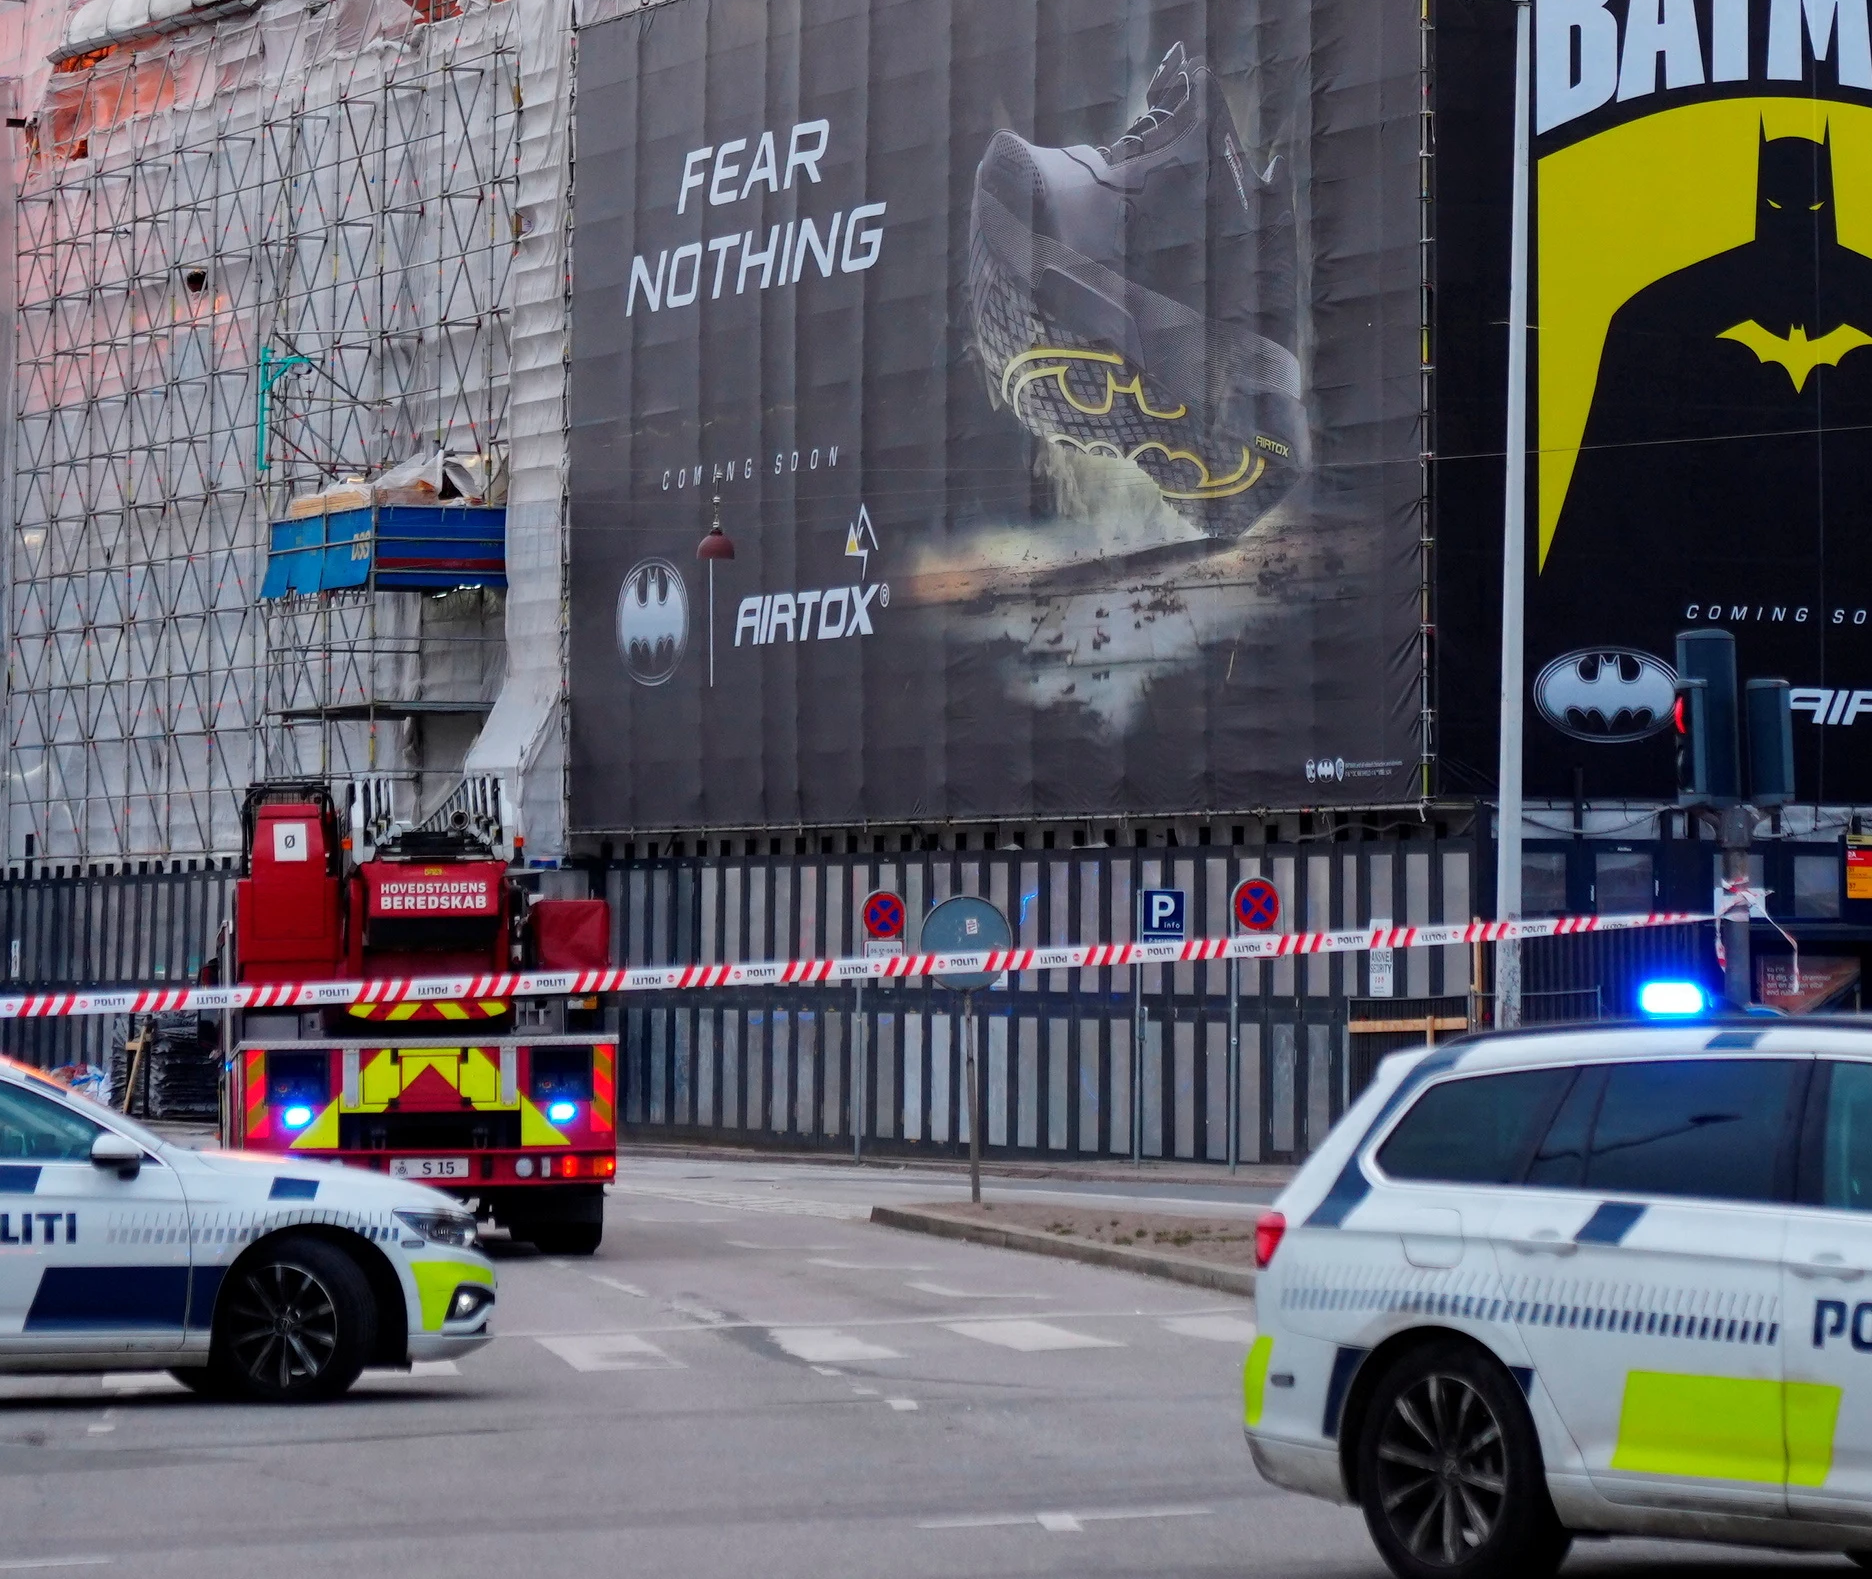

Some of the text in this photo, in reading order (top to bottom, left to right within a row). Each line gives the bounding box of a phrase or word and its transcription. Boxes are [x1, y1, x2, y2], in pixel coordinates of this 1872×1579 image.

[677, 119, 830, 216] FEAR
[625, 202, 888, 318] NOTHING
[1255, 434, 1291, 459] AIRTOX
[661, 445, 840, 491] COMING SOON
[1685, 604, 1810, 623] COMING
[380, 881, 487, 895] HOVEDSTADENS
[380, 894, 488, 910] BEREDSKAB
[1151, 895, 1176, 929] P
[1163, 921, 1181, 930] info
[1337, 935, 1365, 945] POLITI
[1147, 946, 1175, 957] POLITI
[1234, 944, 1261, 954] POLITI
[950, 957, 979, 968] POLITI
[1040, 954, 1068, 965] POLITI
[746, 967, 776, 978] POLITI
[839, 966, 869, 976] POLITI
[536, 977, 567, 988] POLITI
[632, 975, 662, 986] POLITI
[318, 988, 350, 998] POLITI
[417, 984, 449, 996] POLITI
[93, 996, 126, 1007] POLITI
[196, 995, 228, 1007] POLITI
[422, 1161, 455, 1175] S 15
